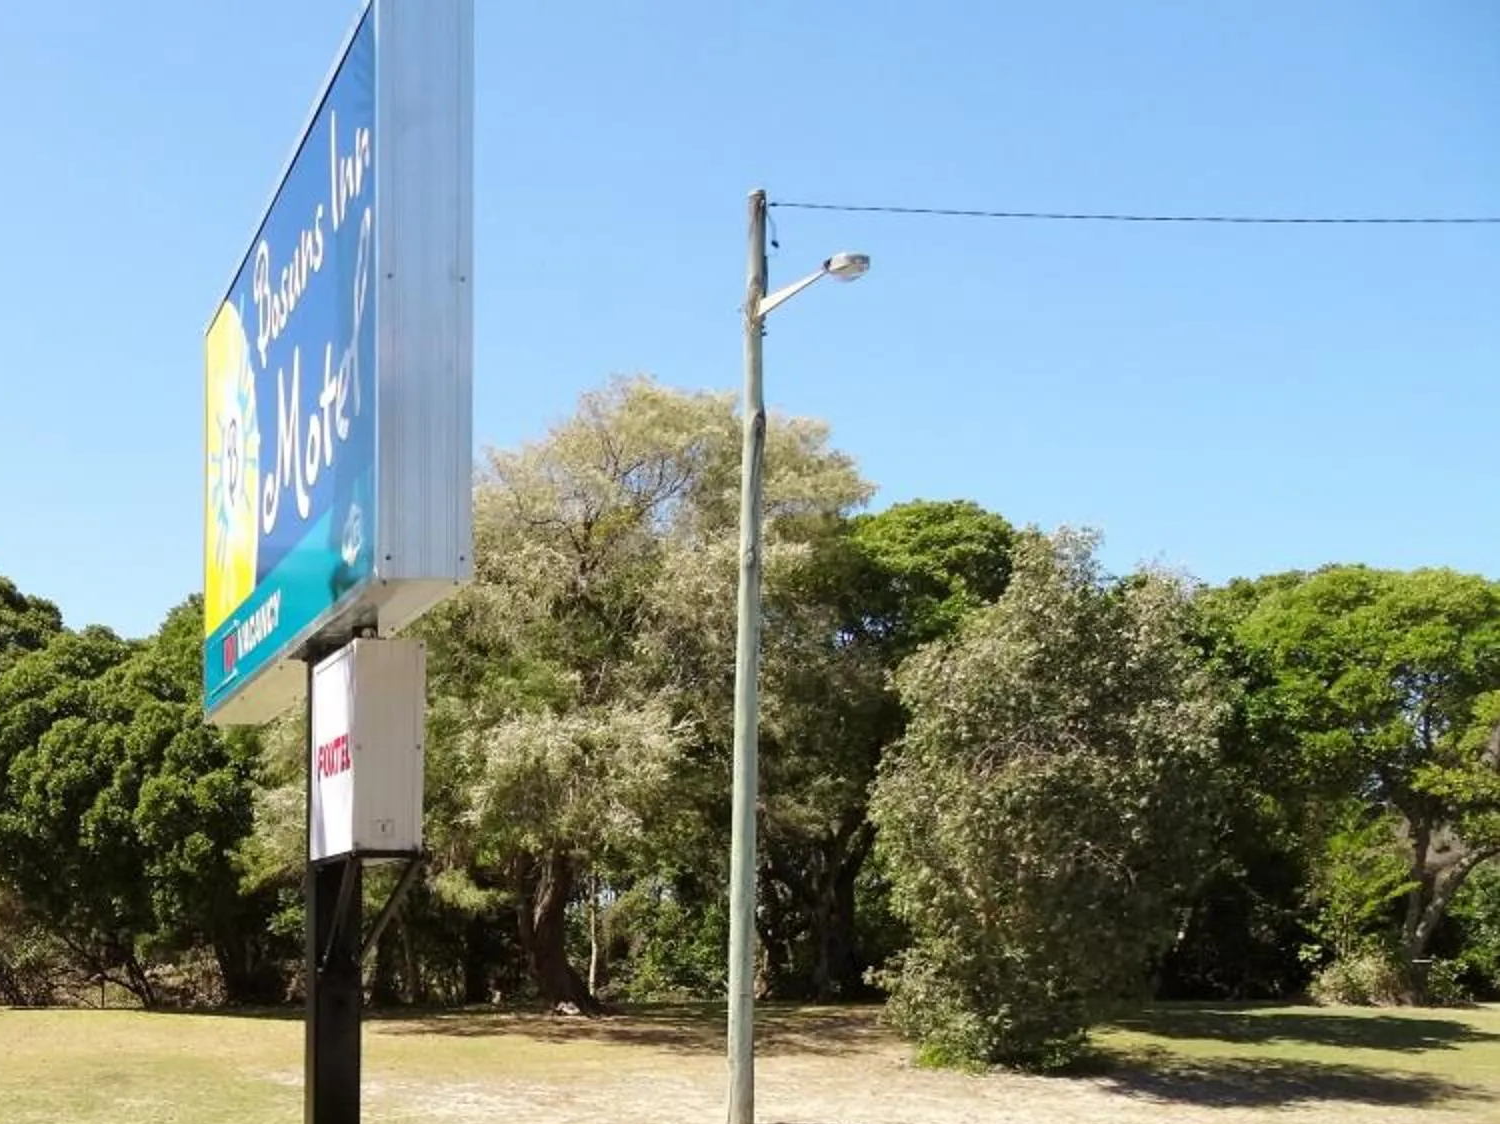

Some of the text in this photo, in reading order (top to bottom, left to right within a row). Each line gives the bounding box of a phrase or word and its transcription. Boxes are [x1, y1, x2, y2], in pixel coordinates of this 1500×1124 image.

[253, 109, 370, 369] Bosuns Inn
[263, 206, 371, 535] Motel
